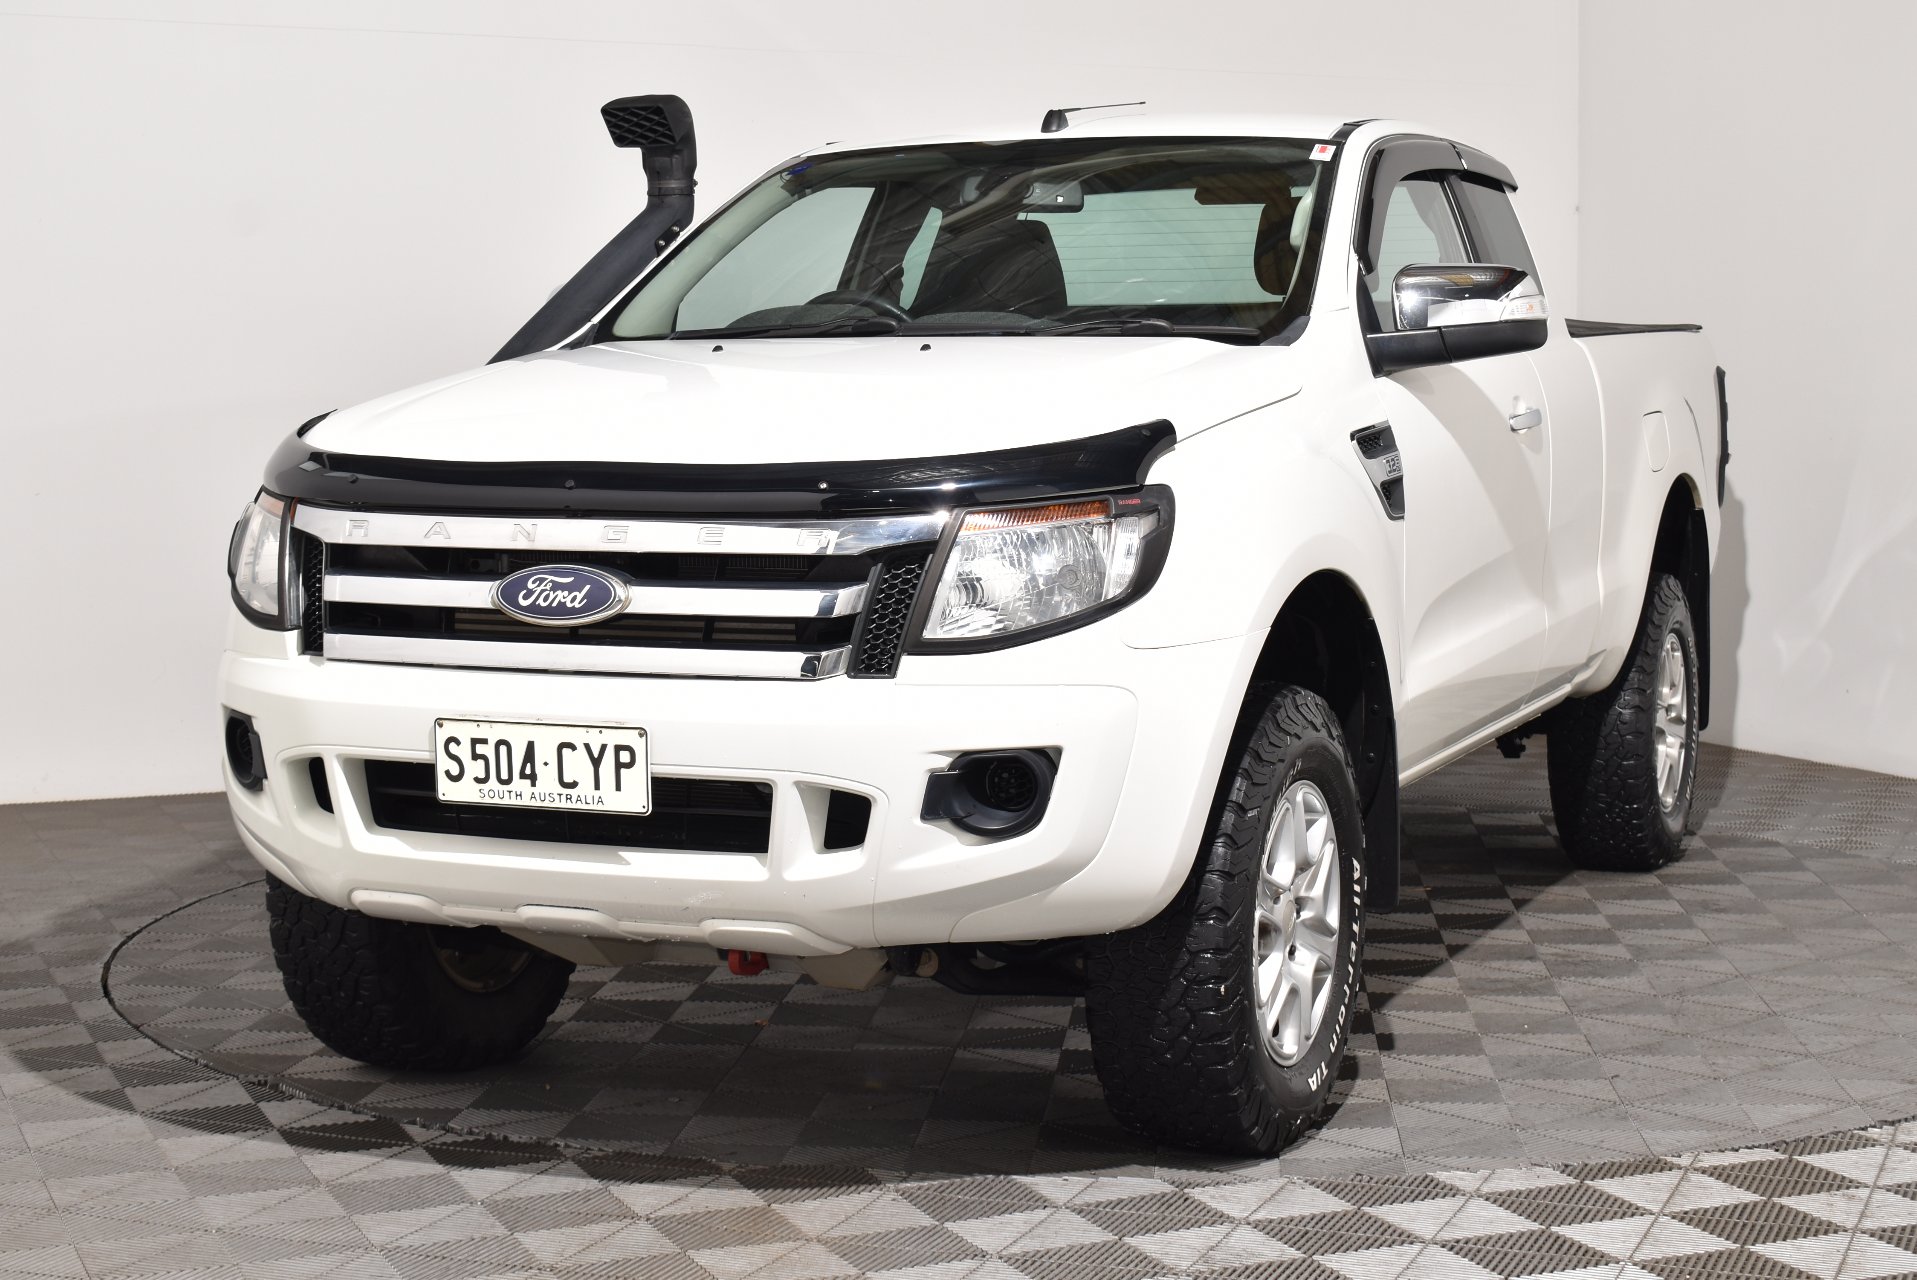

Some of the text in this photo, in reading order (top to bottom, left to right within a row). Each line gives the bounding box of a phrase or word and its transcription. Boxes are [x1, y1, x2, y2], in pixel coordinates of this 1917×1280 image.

[346, 519, 831, 547] RANGER
[518, 573, 588, 610] Ford
[478, 788, 605, 806] SOUTH AUSTRALIA
[1328, 856, 1360, 1054] All-Terrain
